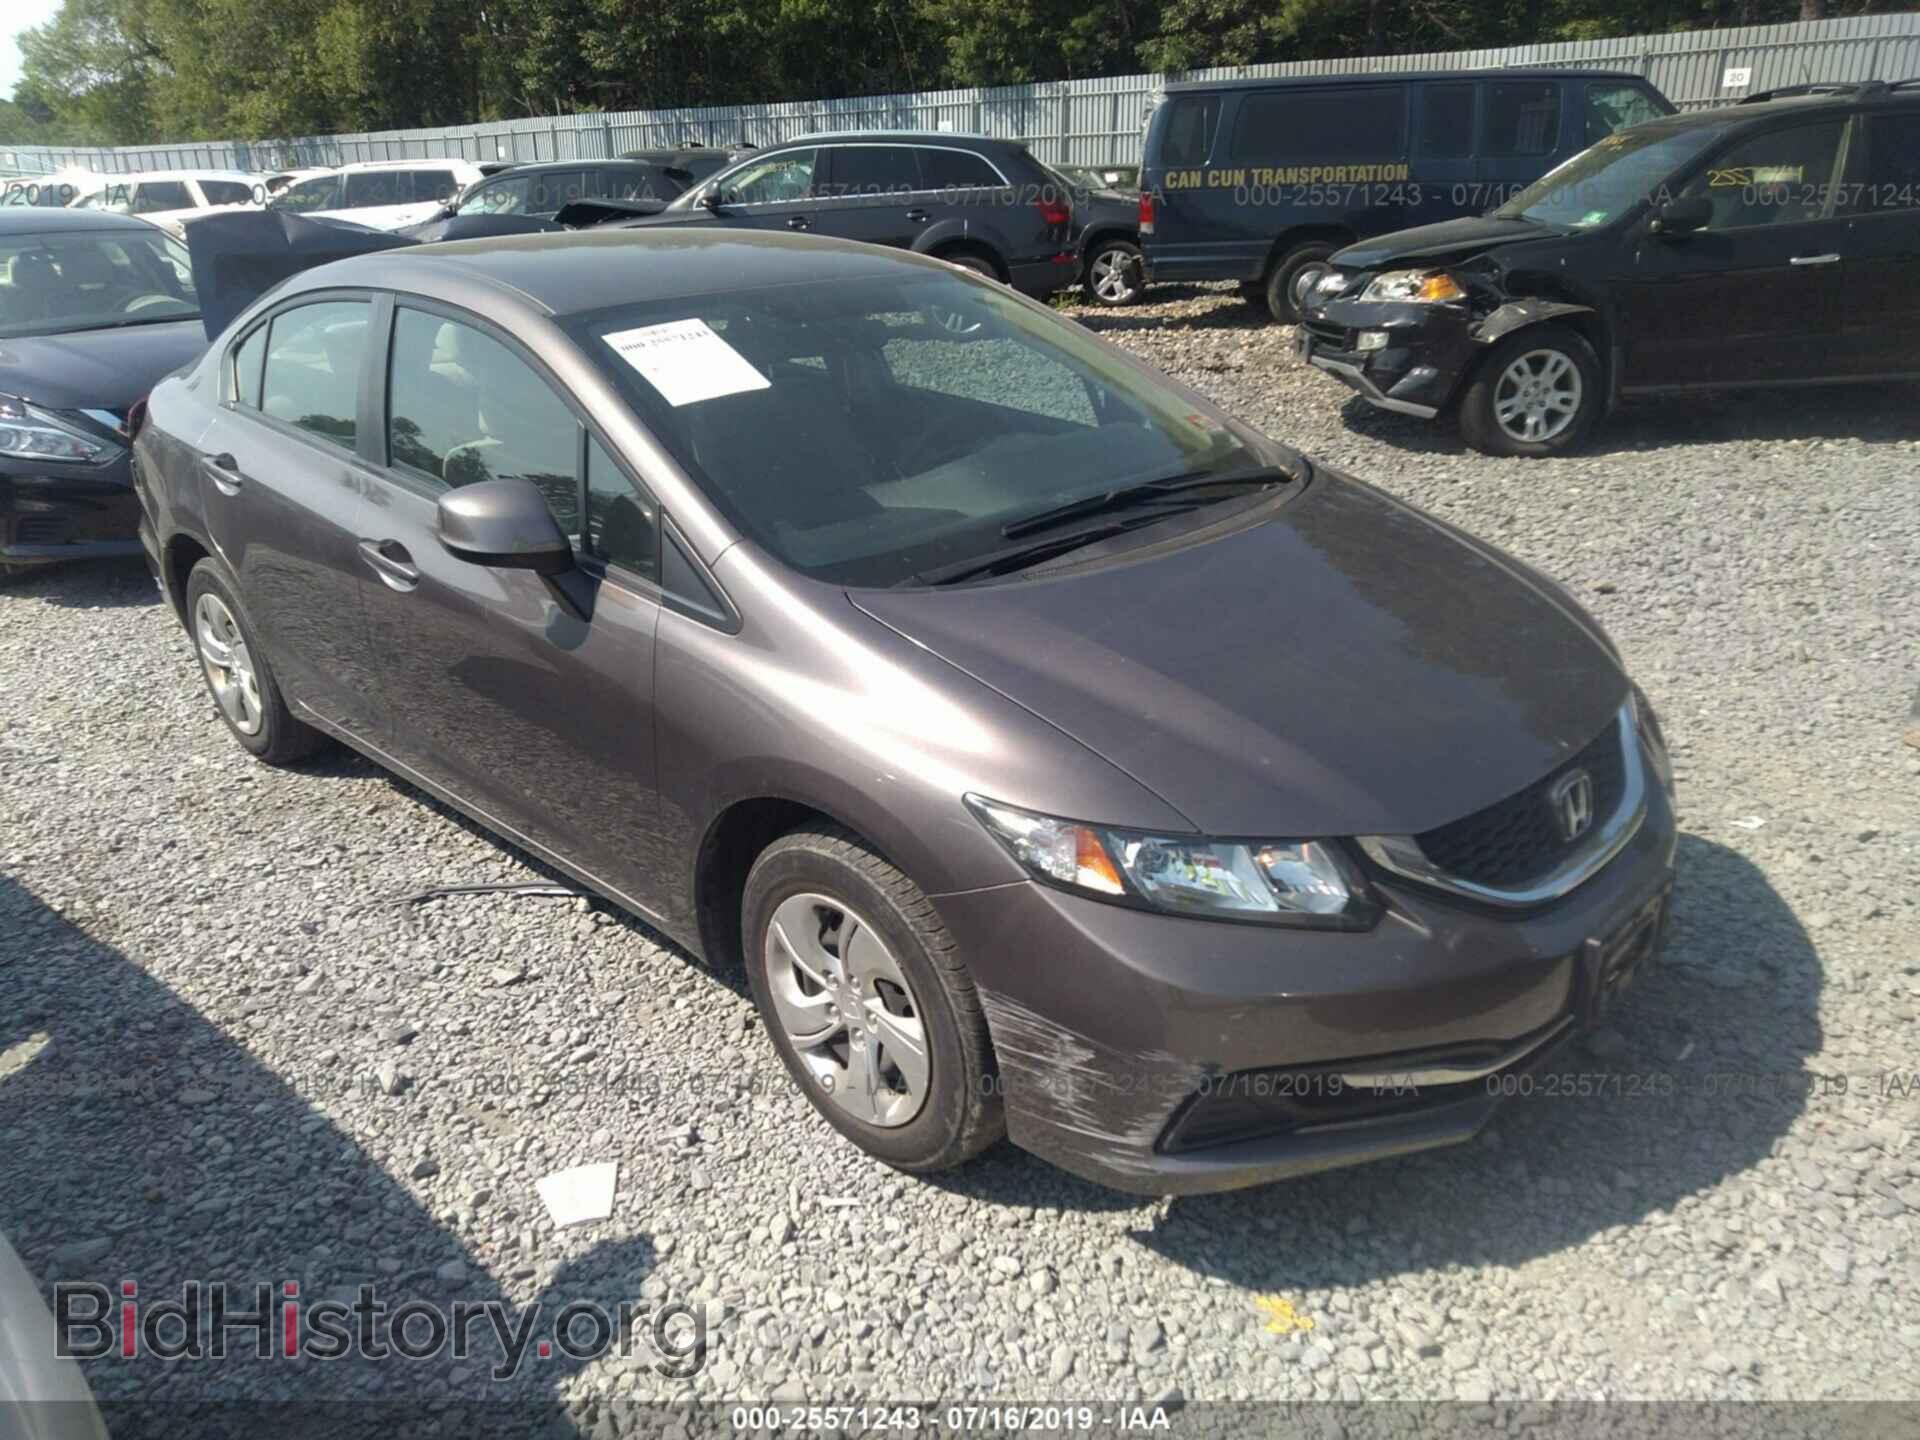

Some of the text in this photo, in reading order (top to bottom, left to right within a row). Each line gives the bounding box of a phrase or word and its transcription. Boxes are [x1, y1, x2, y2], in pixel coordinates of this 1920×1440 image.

[1729, 72, 1745, 82] 20
[1165, 164, 1409, 189] CAN CUN TRANSPORTATION
